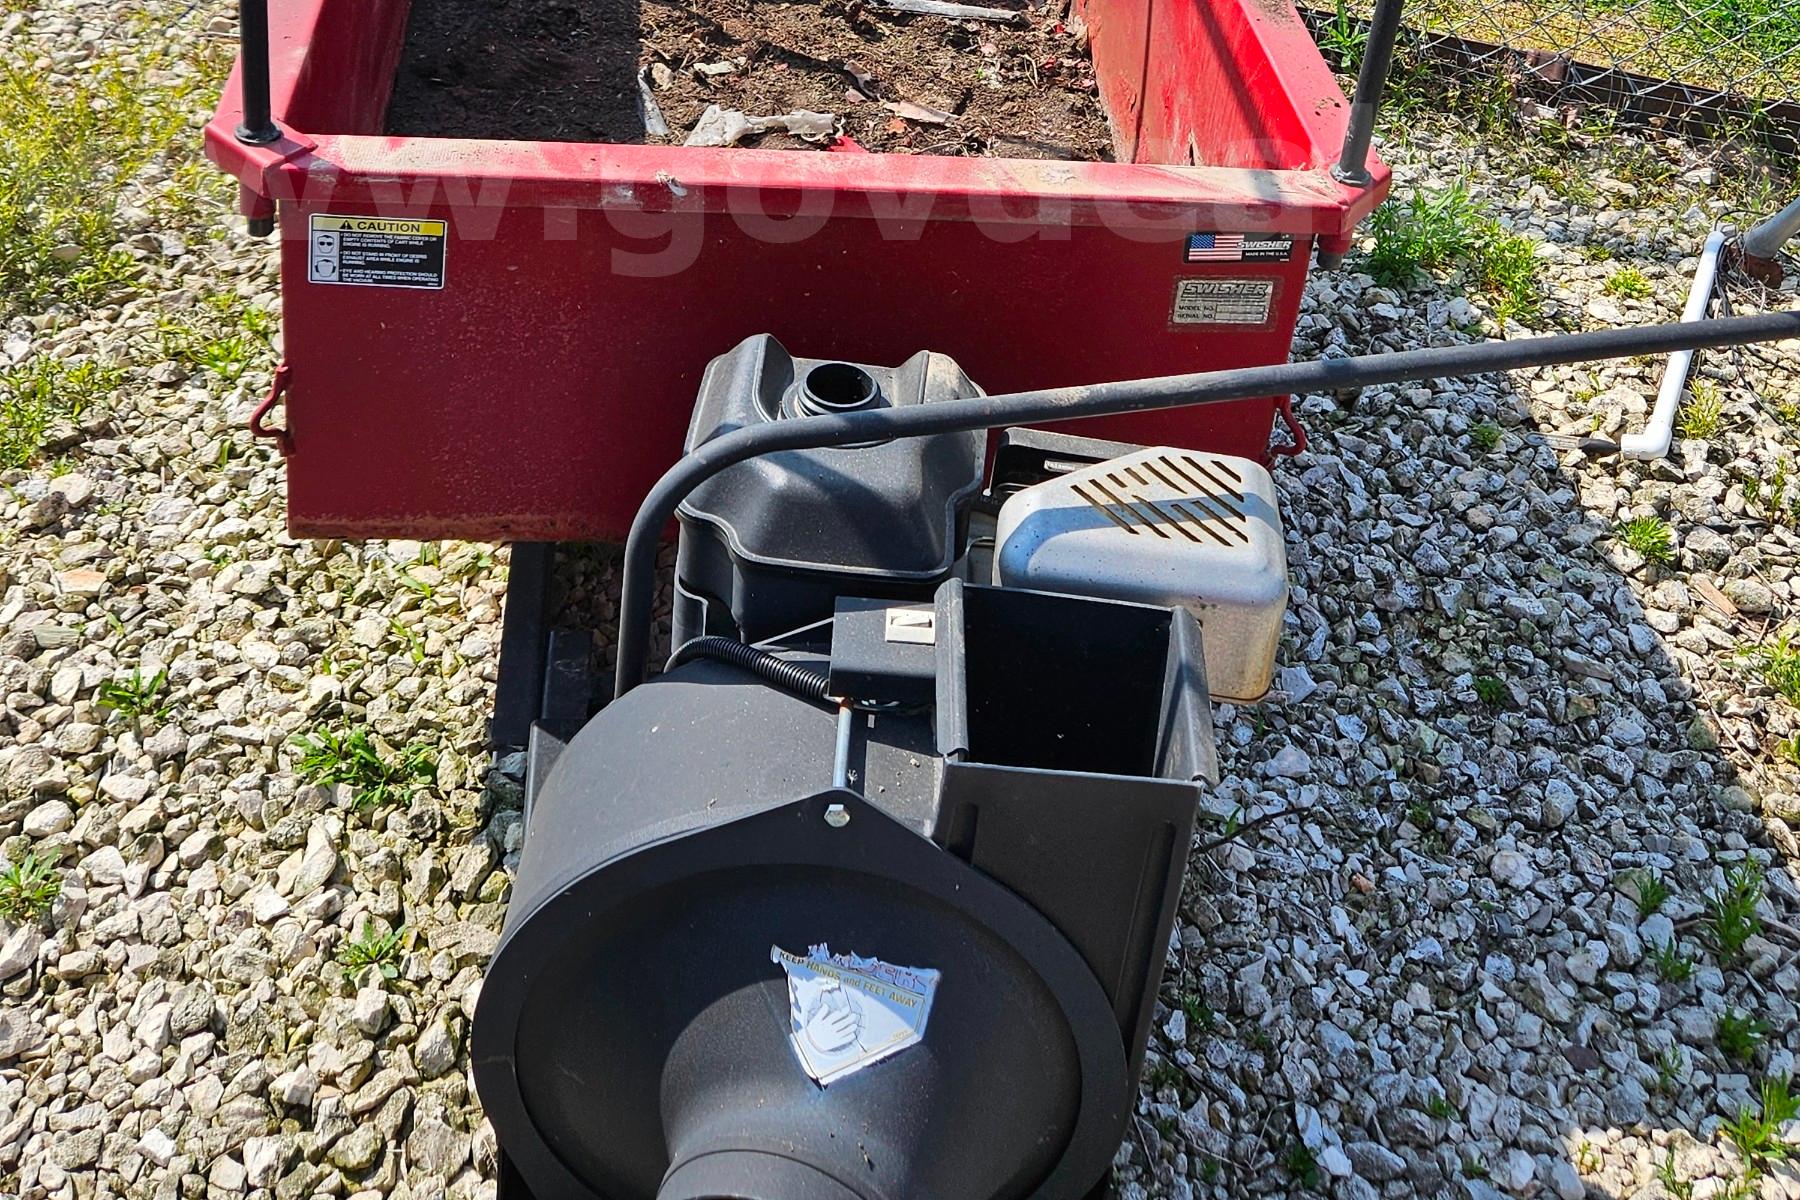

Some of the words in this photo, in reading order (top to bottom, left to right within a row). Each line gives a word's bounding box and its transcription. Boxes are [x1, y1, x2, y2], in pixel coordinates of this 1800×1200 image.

[357, 221, 420, 233] CAUTION
[1237, 241, 1292, 250] SWISHER
[1182, 283, 1268, 298] SWISHER
[779, 951, 804, 965] KEEP
[806, 961, 841, 981] HANDS
[844, 976, 860, 988] and
[863, 981, 886, 996] FEET
[889, 991, 917, 1008] AWAY
